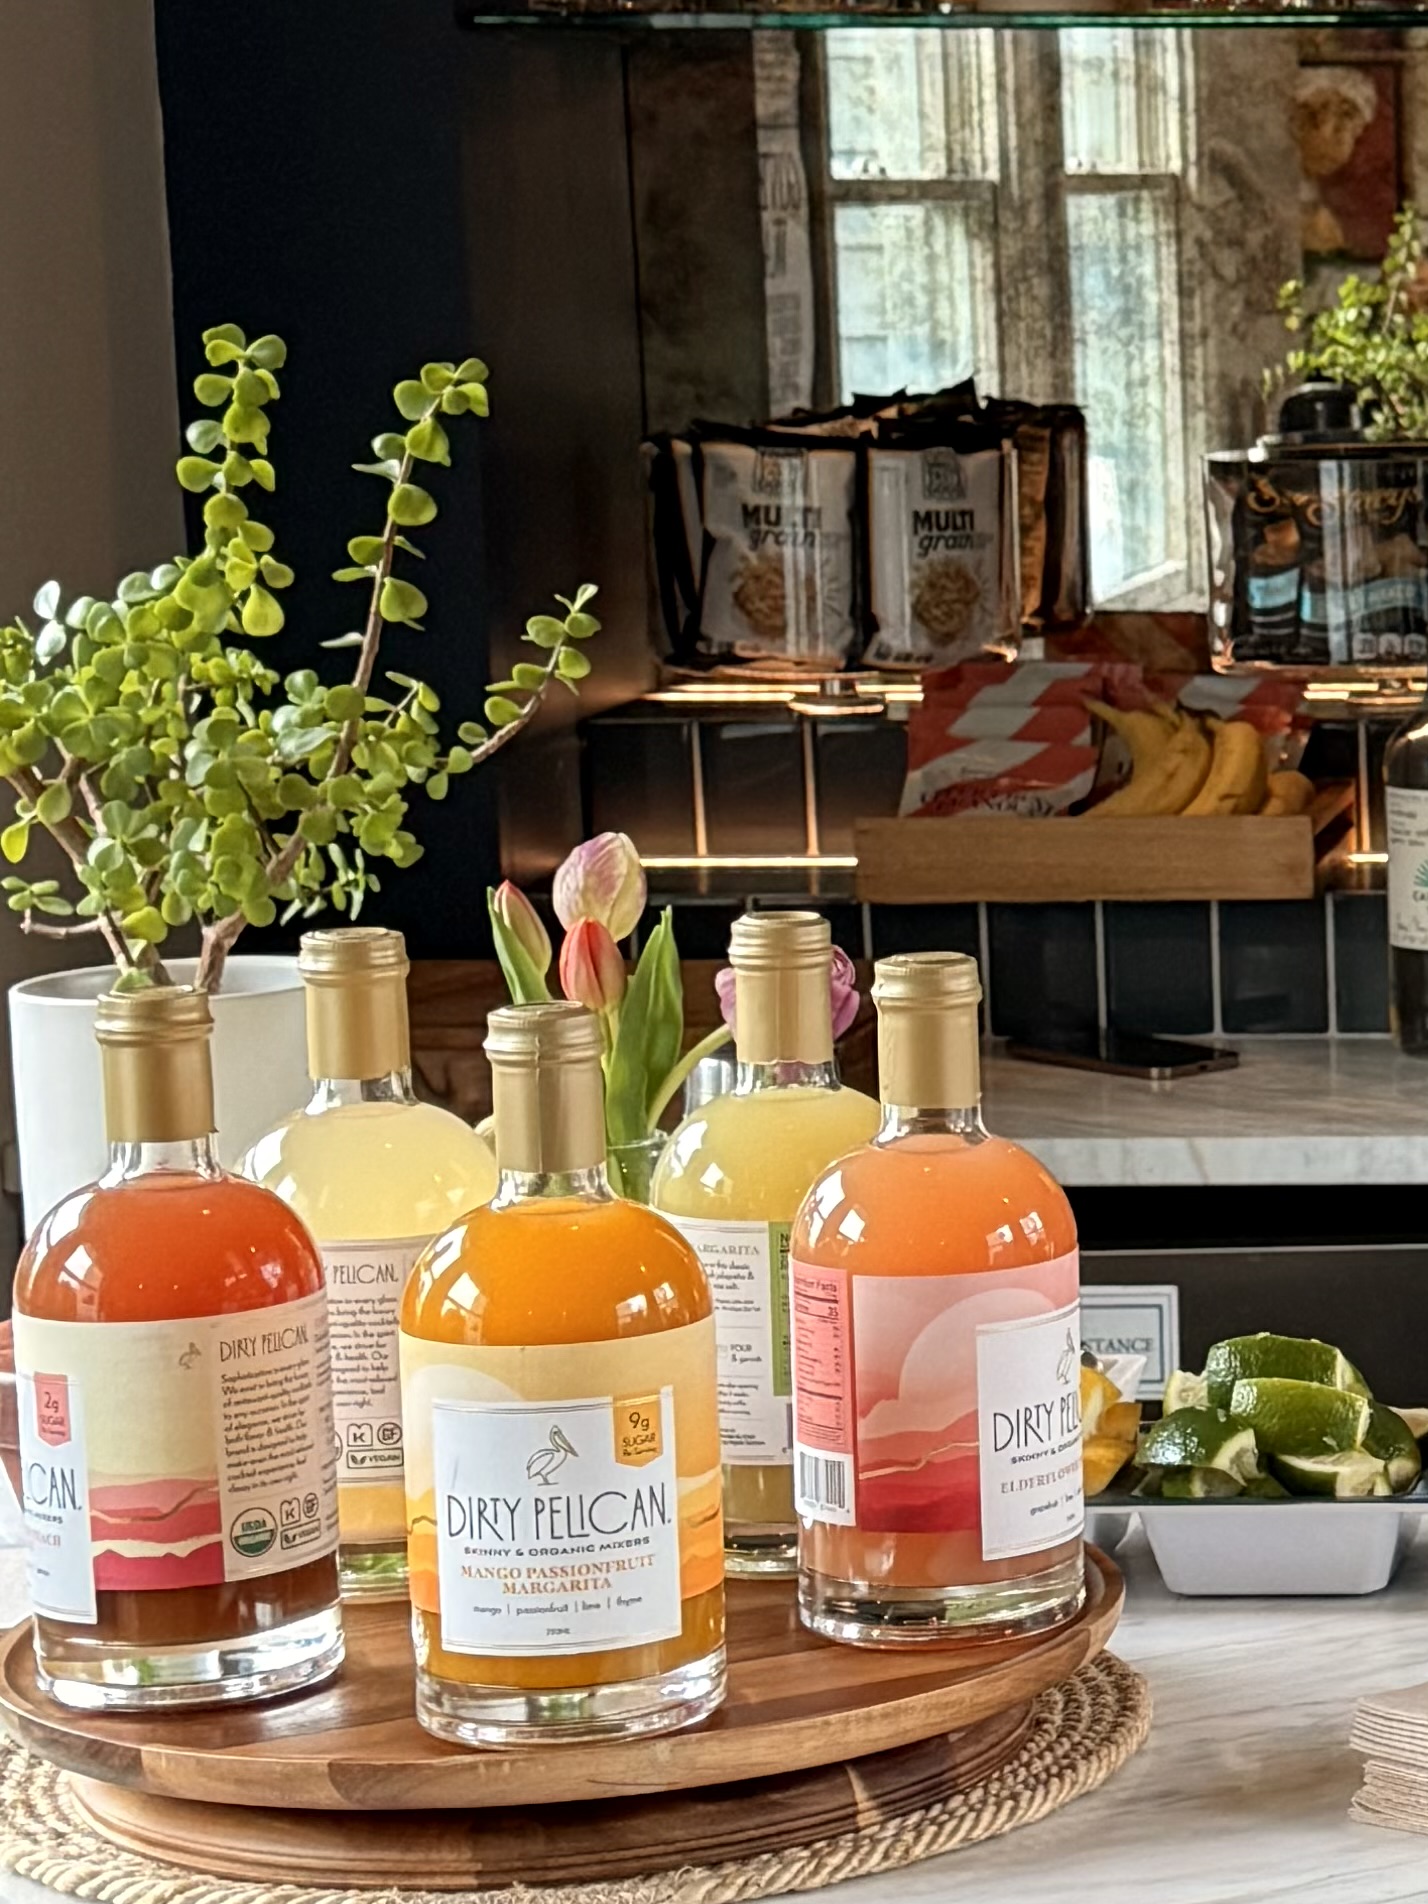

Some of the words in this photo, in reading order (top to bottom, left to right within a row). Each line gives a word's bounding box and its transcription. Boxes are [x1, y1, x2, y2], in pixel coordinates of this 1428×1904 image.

[912, 509, 975, 536] MULTI
[220, 1337, 258, 1363] DIRTY
[44, 1391, 60, 1414] 2g
[628, 1411, 650, 1432] 9g
[993, 1401, 1055, 1452] DIRTY
[352, 1432, 366, 1443] K
[284, 1507, 295, 1521] K
[446, 1494, 522, 1542] DIRTY
[464, 1545, 511, 1557] SKINNY
[515, 1545, 524, 1557] &
[528, 1544, 596, 1557] ORGANIC
[599, 1536, 651, 1552] MIXERS
[460, 1564, 522, 1580] MANGO
[526, 1553, 657, 1579] PASSIONFRUIT
[502, 1577, 613, 1595] MARGARITA
